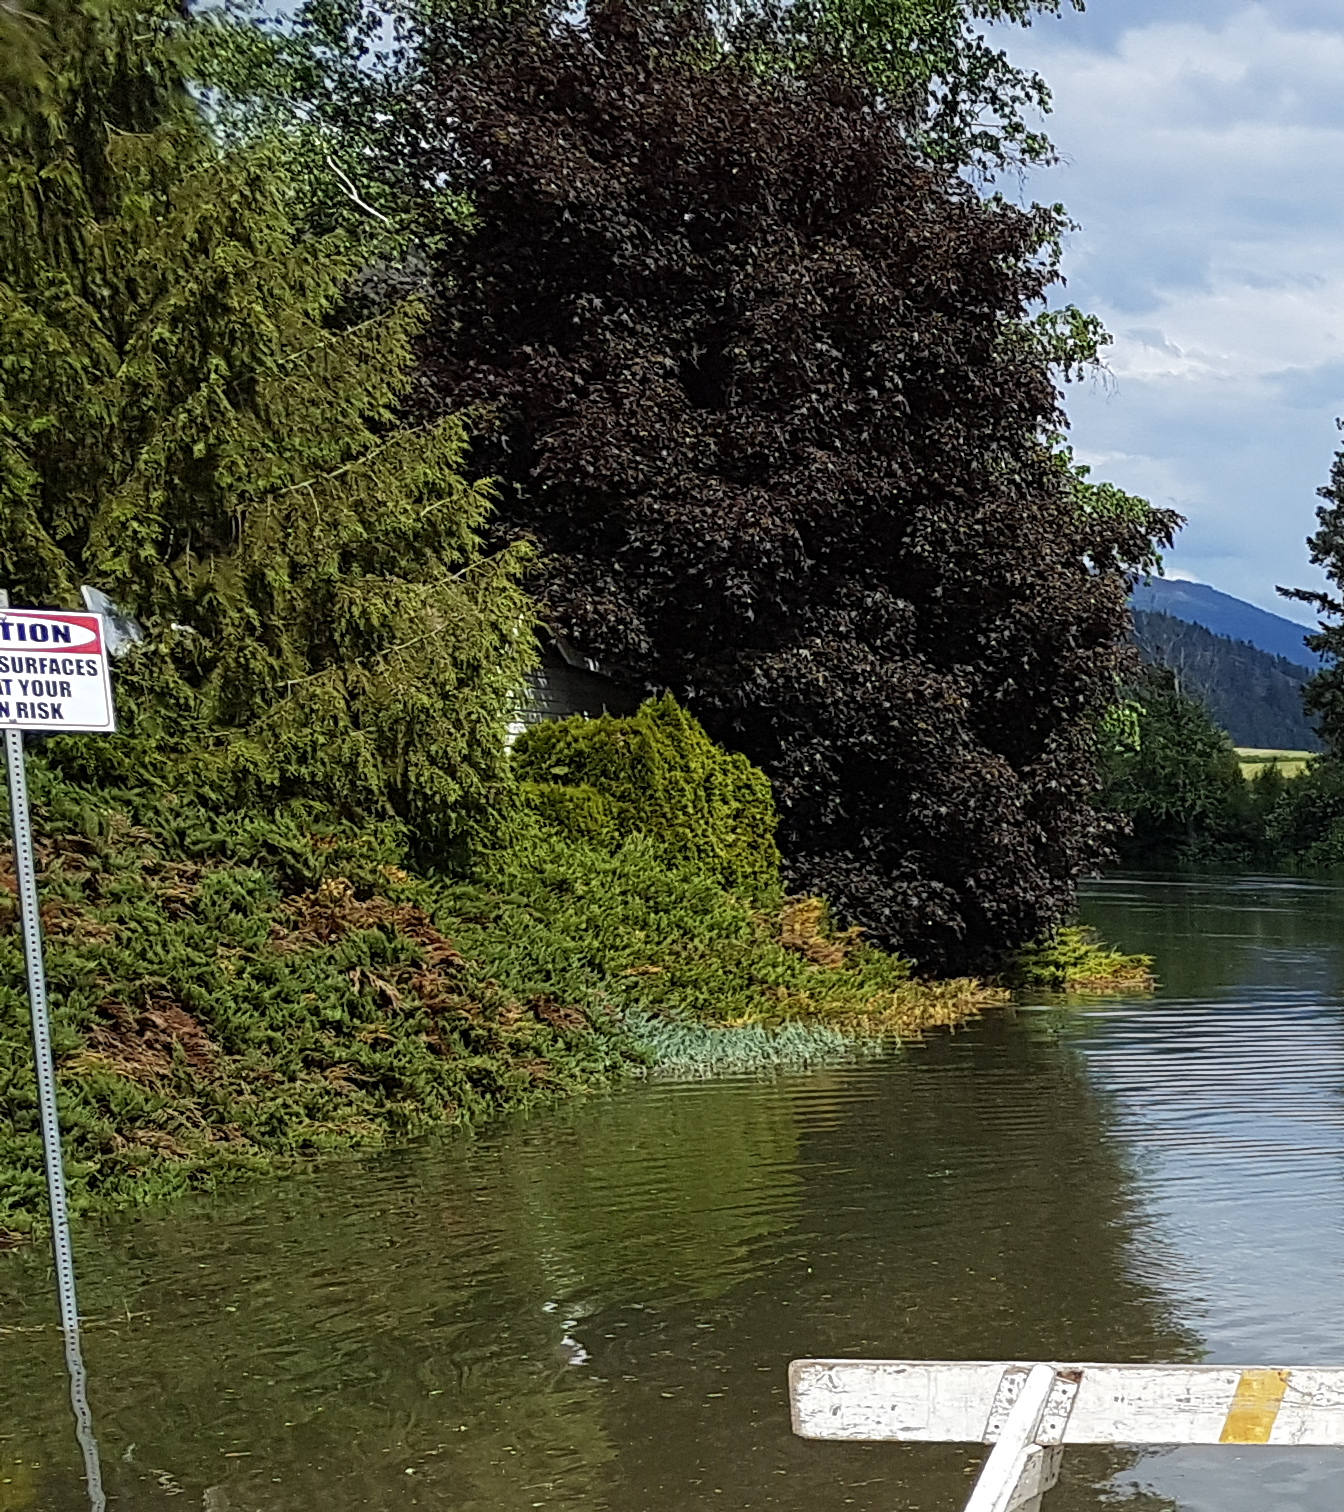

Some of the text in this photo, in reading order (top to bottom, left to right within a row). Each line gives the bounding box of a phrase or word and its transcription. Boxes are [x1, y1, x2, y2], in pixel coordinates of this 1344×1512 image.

[0, 656, 98, 676] SURFACES
[17, 679, 72, 697] YOUR
[16, 702, 64, 719] RISK
